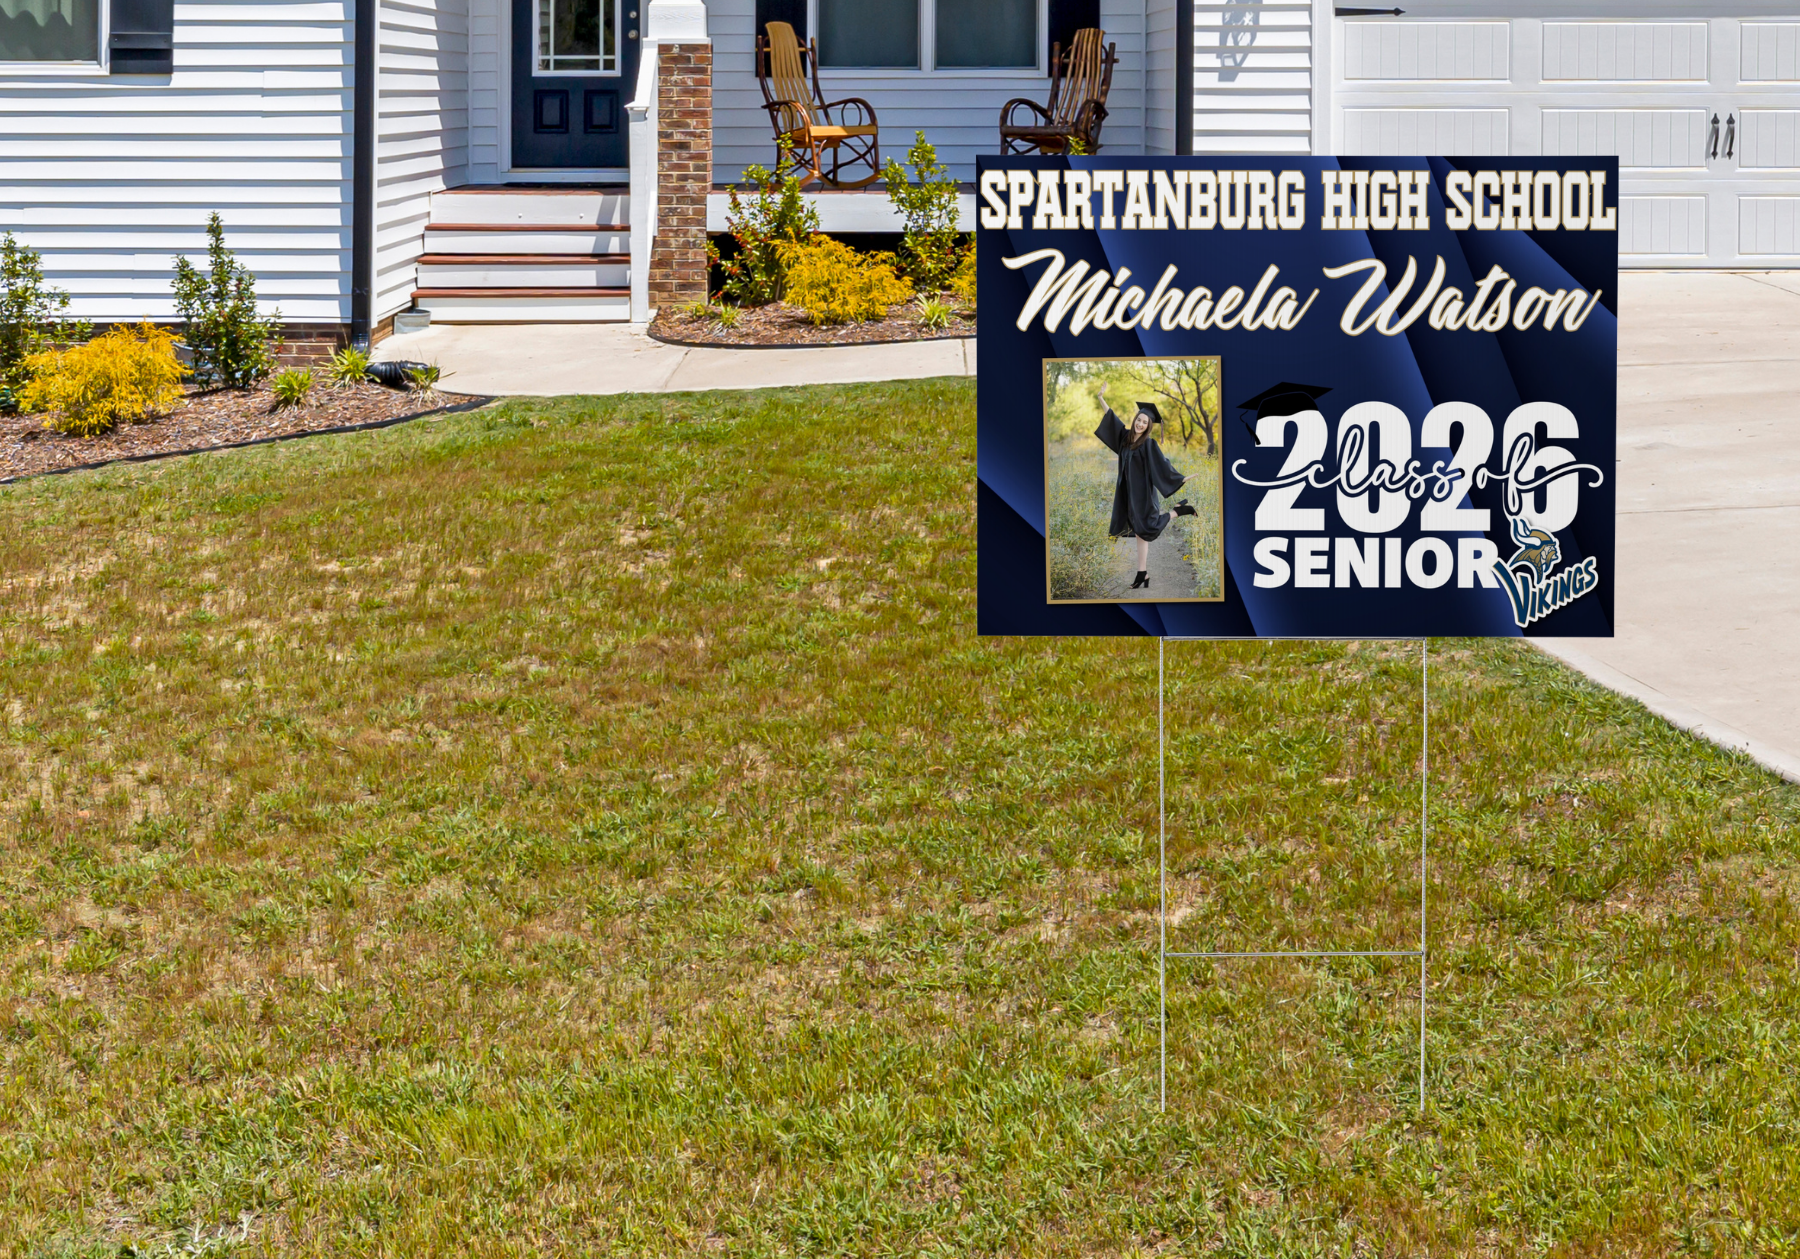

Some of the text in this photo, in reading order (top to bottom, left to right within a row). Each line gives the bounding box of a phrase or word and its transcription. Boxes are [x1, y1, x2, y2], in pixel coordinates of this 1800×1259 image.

[980, 169, 1617, 231] SPARTANBURG HIGH SCHOOL
[1001, 248, 1603, 337] Michaela Watson
[1231, 423, 1604, 515] class of
[1254, 401, 1580, 534] 2026
[1253, 536, 1501, 589] SENIOR
